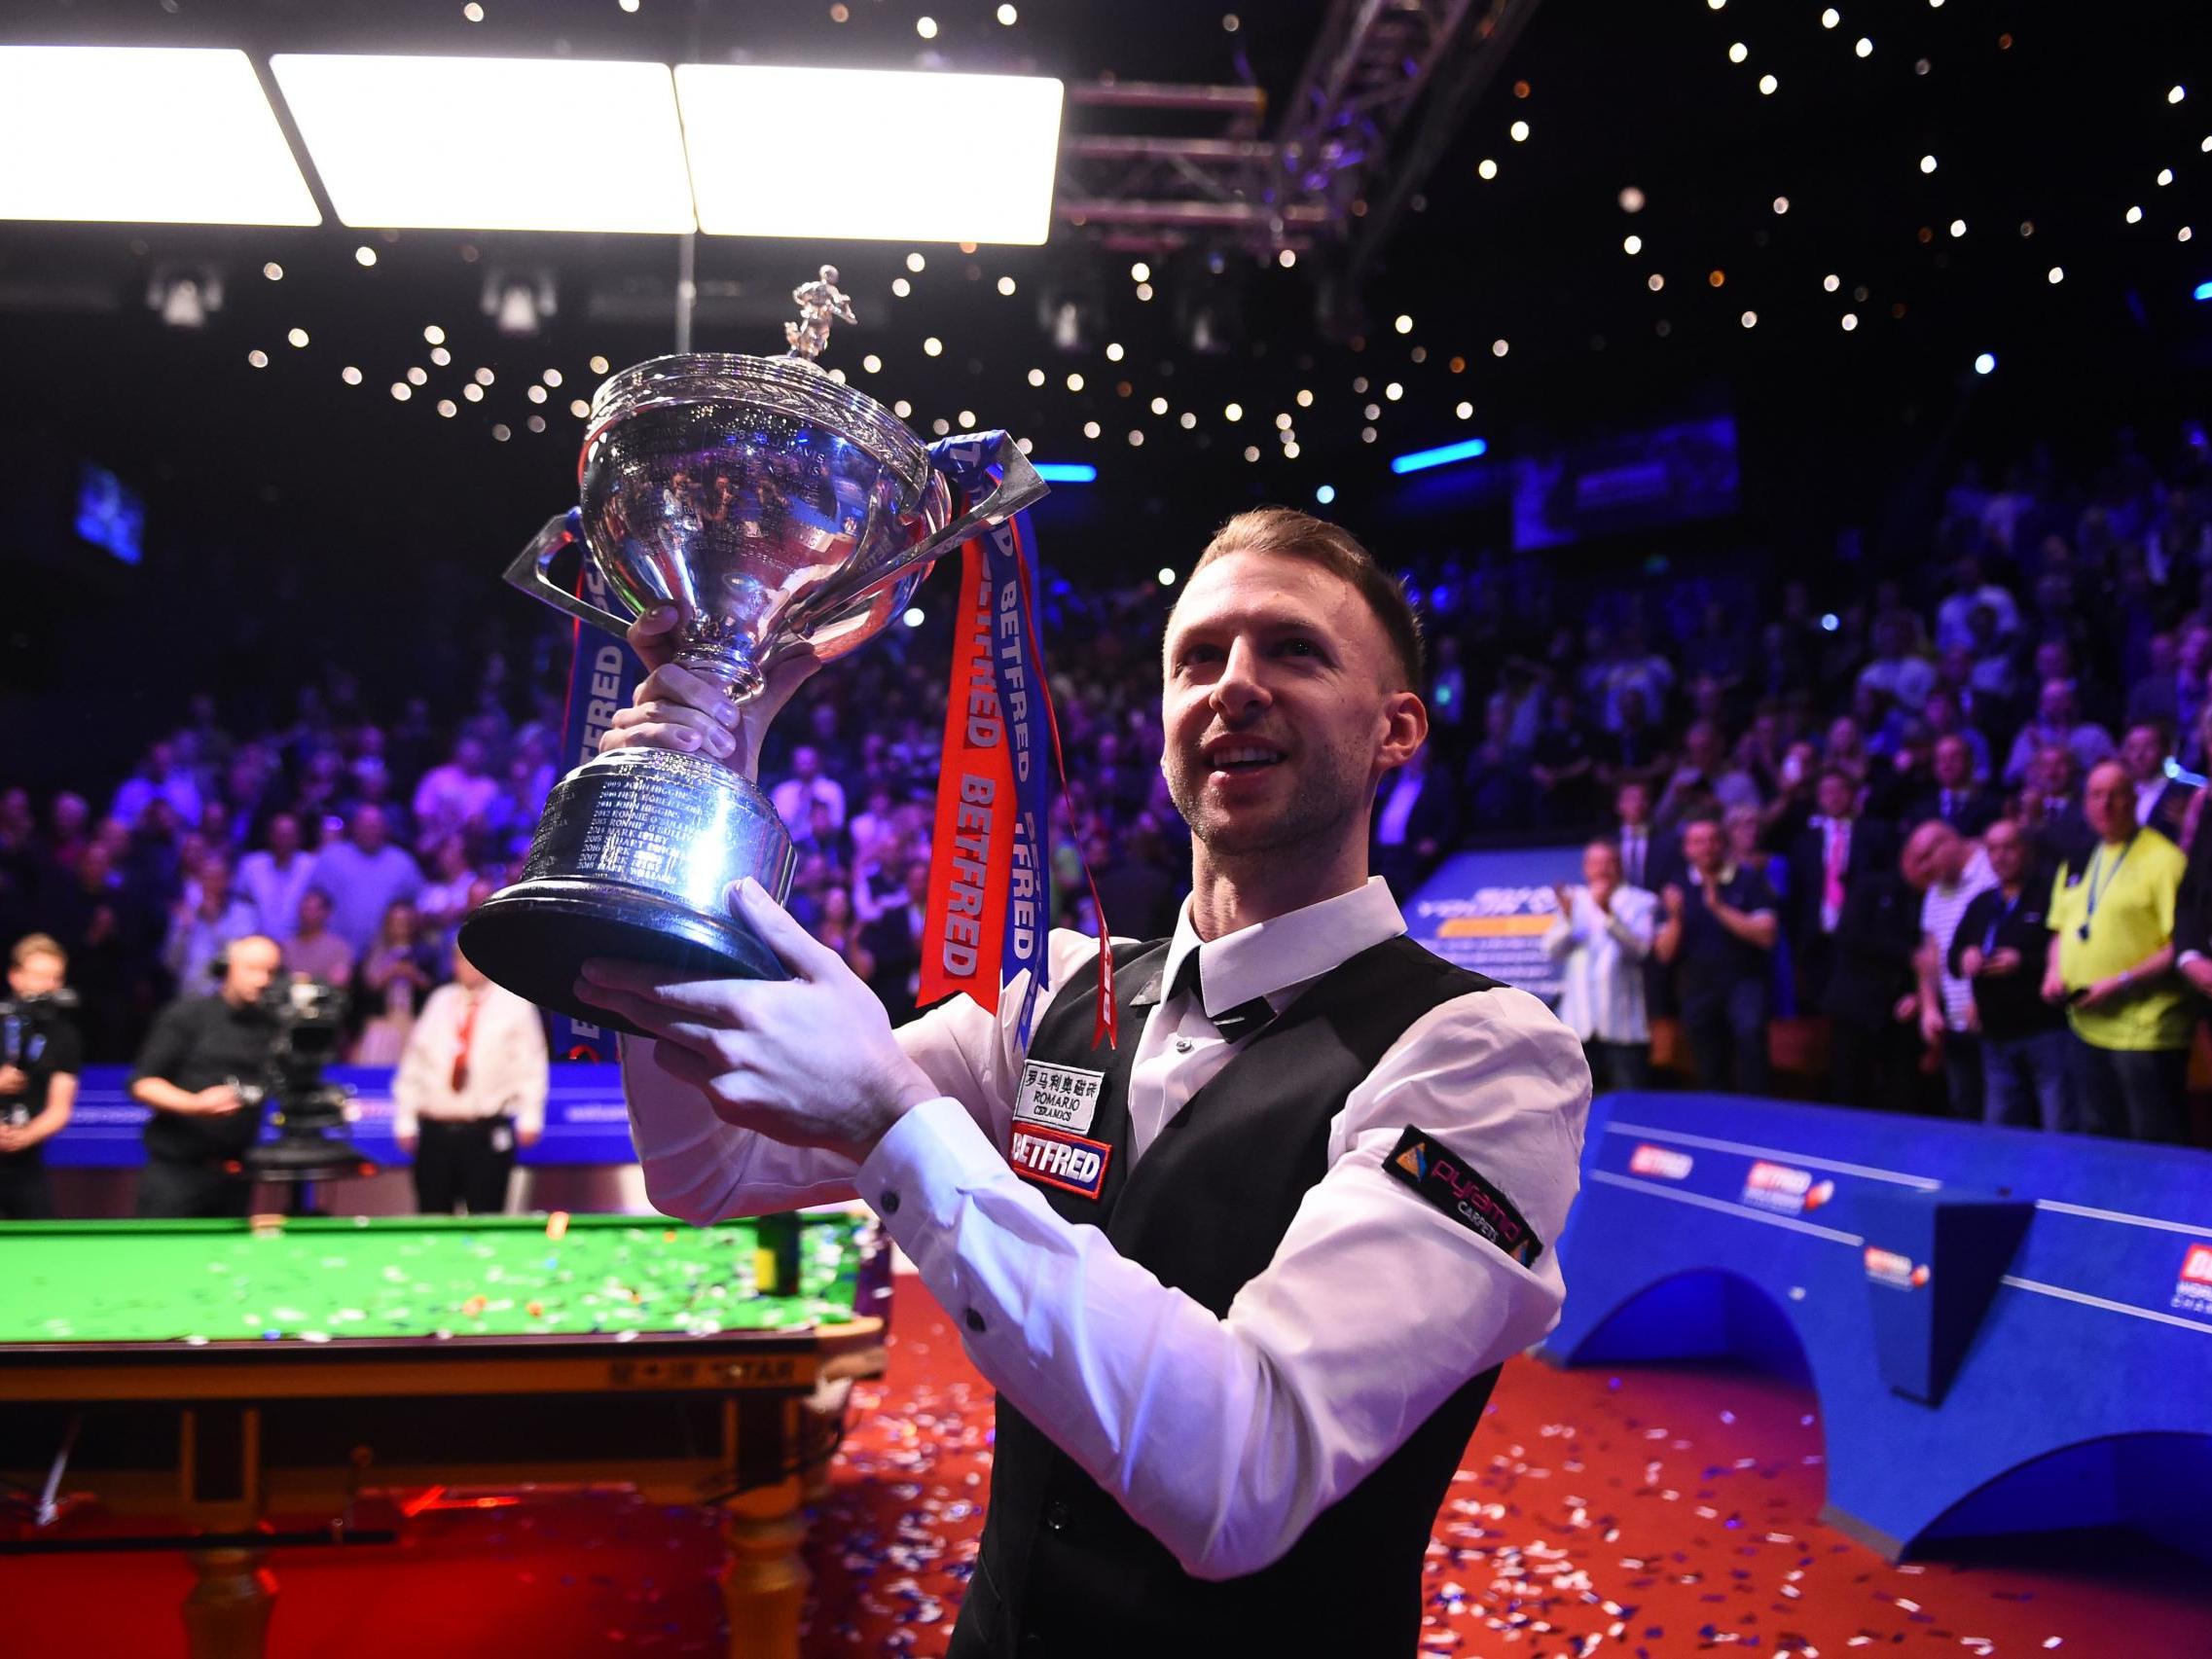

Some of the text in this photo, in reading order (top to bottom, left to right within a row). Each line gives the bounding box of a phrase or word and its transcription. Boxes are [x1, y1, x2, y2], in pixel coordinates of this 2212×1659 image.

[1000, 581, 1030, 781] BETFRED
[612, 810, 648, 822] RONNIE
[609, 818, 644, 830] RONNIE
[607, 827, 636, 839] MARK
[582, 844, 601, 852] 2016
[579, 852, 598, 861] 2017
[576, 861, 595, 870] 2018
[597, 863, 625, 874] MARK
[943, 773, 996, 977] BETFRED
[1033, 1091, 1081, 1111] ROMARIO
[1033, 1105, 1072, 1122] CERAMICS
[1011, 1132, 1101, 1184] BETFRED
[1457, 1201, 1500, 1243] CARPETS
